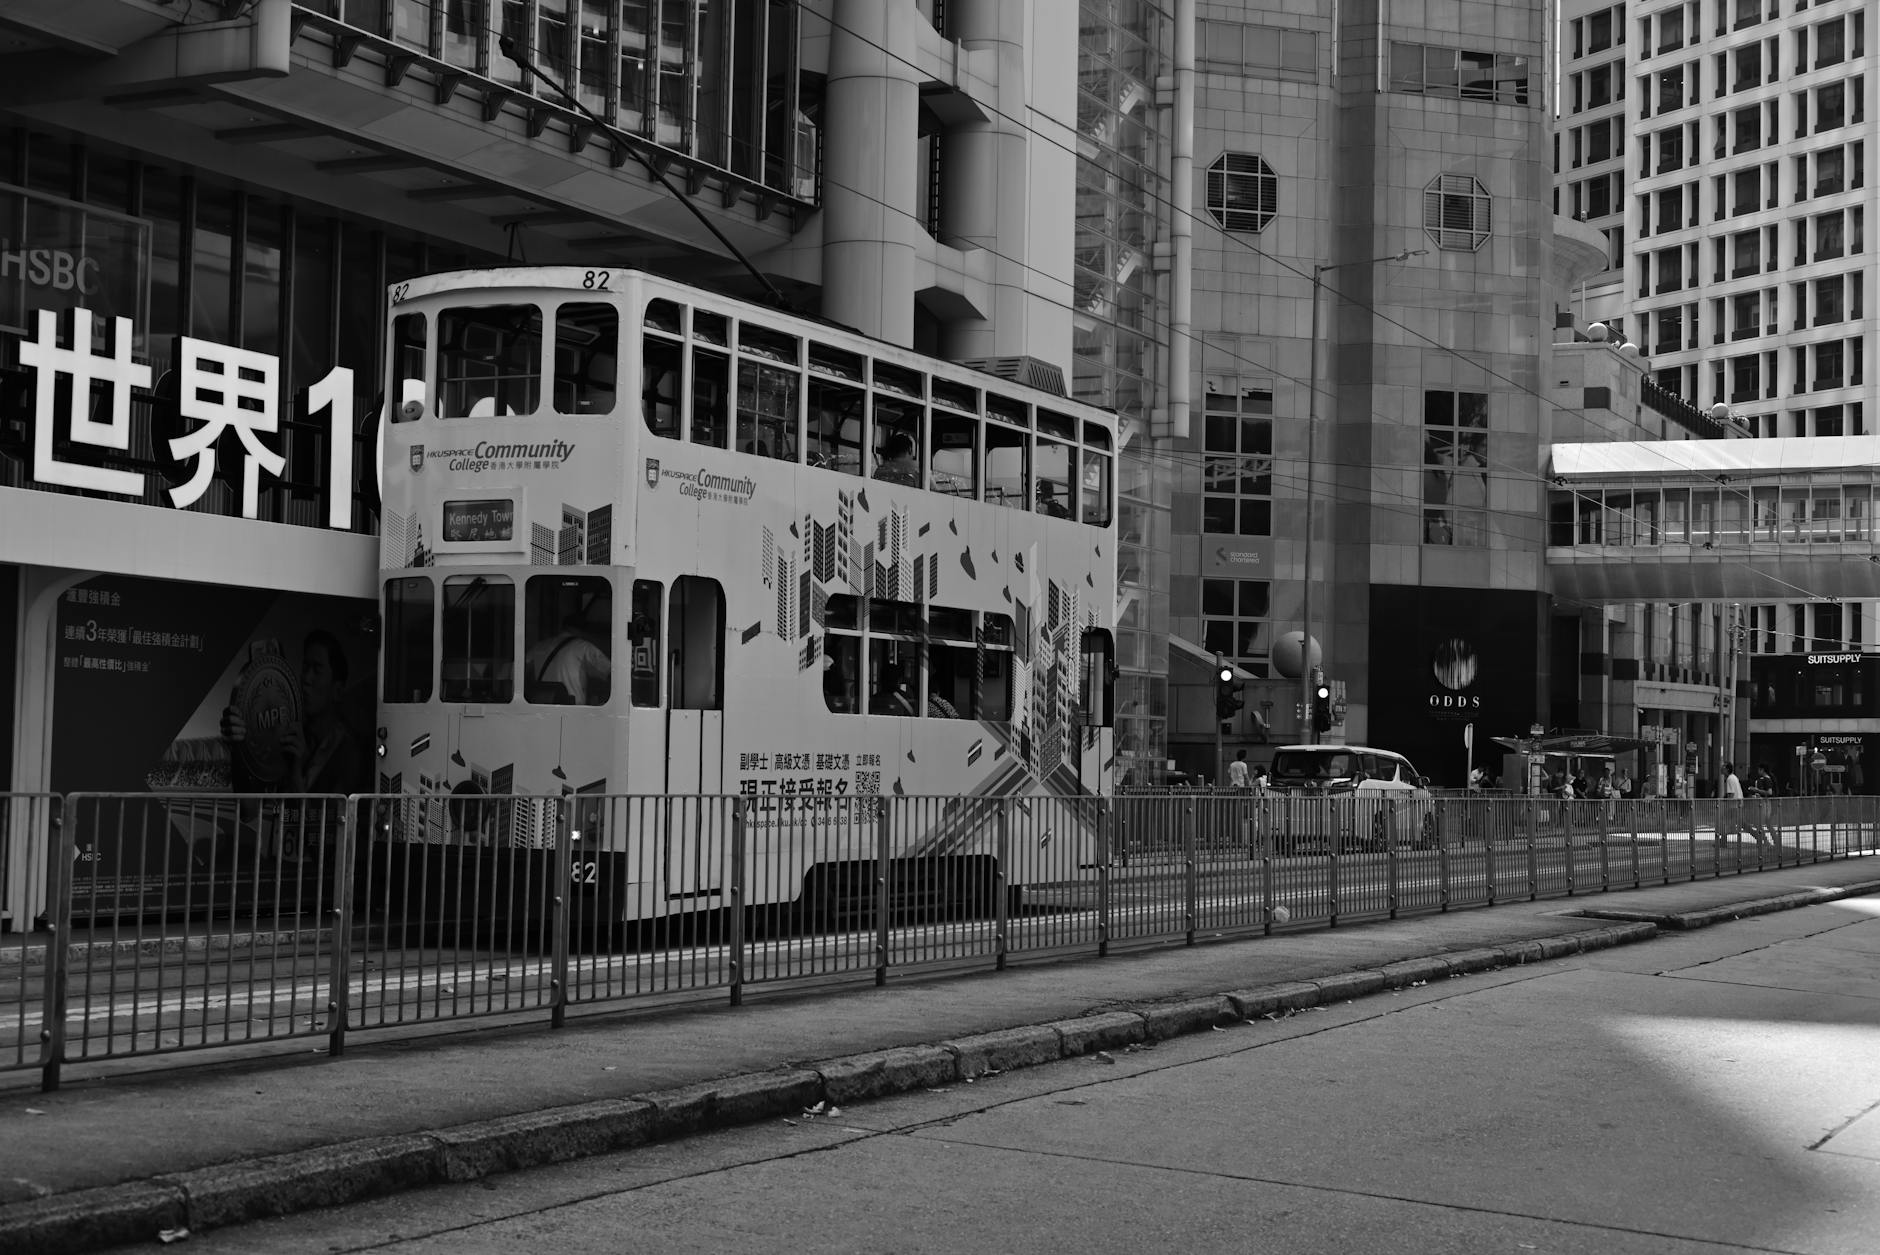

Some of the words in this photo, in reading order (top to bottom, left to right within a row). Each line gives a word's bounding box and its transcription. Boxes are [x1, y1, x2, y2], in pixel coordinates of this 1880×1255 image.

[1, 239, 100, 295] HSBC
[583, 271, 610, 290] 82
[393, 283, 410, 304] 82
[19, 306, 385, 530] 世界1
[474, 439, 576, 462] Community
[449, 458, 490, 472] College
[679, 482, 708, 501] College
[697, 468, 757, 500] Community
[449, 511, 488, 526] Kennedy
[1807, 653, 1861, 664] SUITSUPPLY
[1429, 694, 1480, 708] ODDS
[1820, 736, 1862, 744] SUITSUPPLY
[740, 753, 768, 770] 副學士
[855, 754, 881, 766] 立即報名
[571, 861, 596, 883] 82
